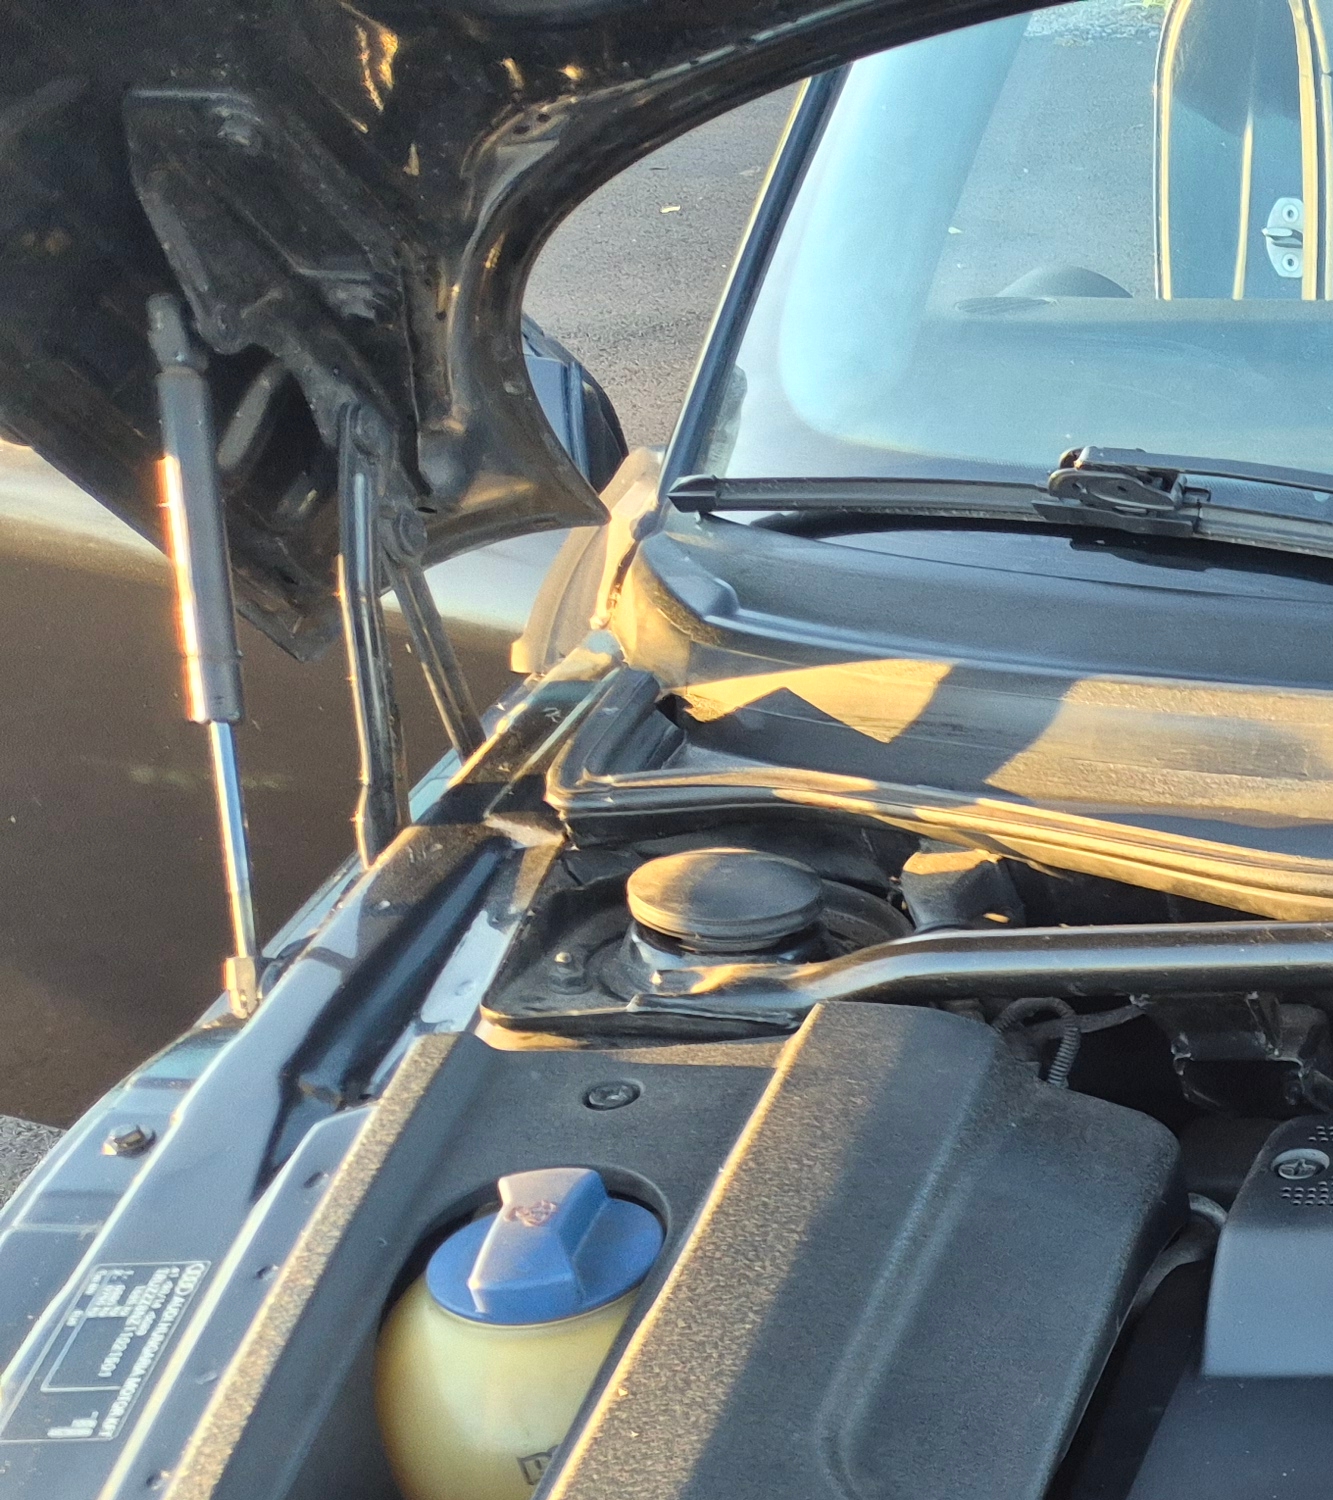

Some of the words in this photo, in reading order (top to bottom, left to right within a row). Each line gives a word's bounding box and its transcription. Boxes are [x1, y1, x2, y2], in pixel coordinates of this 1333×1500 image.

[161, 1296, 185, 1320] AUDI
[131, 1322, 171, 1375] HUNGARIA
[109, 1377, 142, 1415] MOTOR
